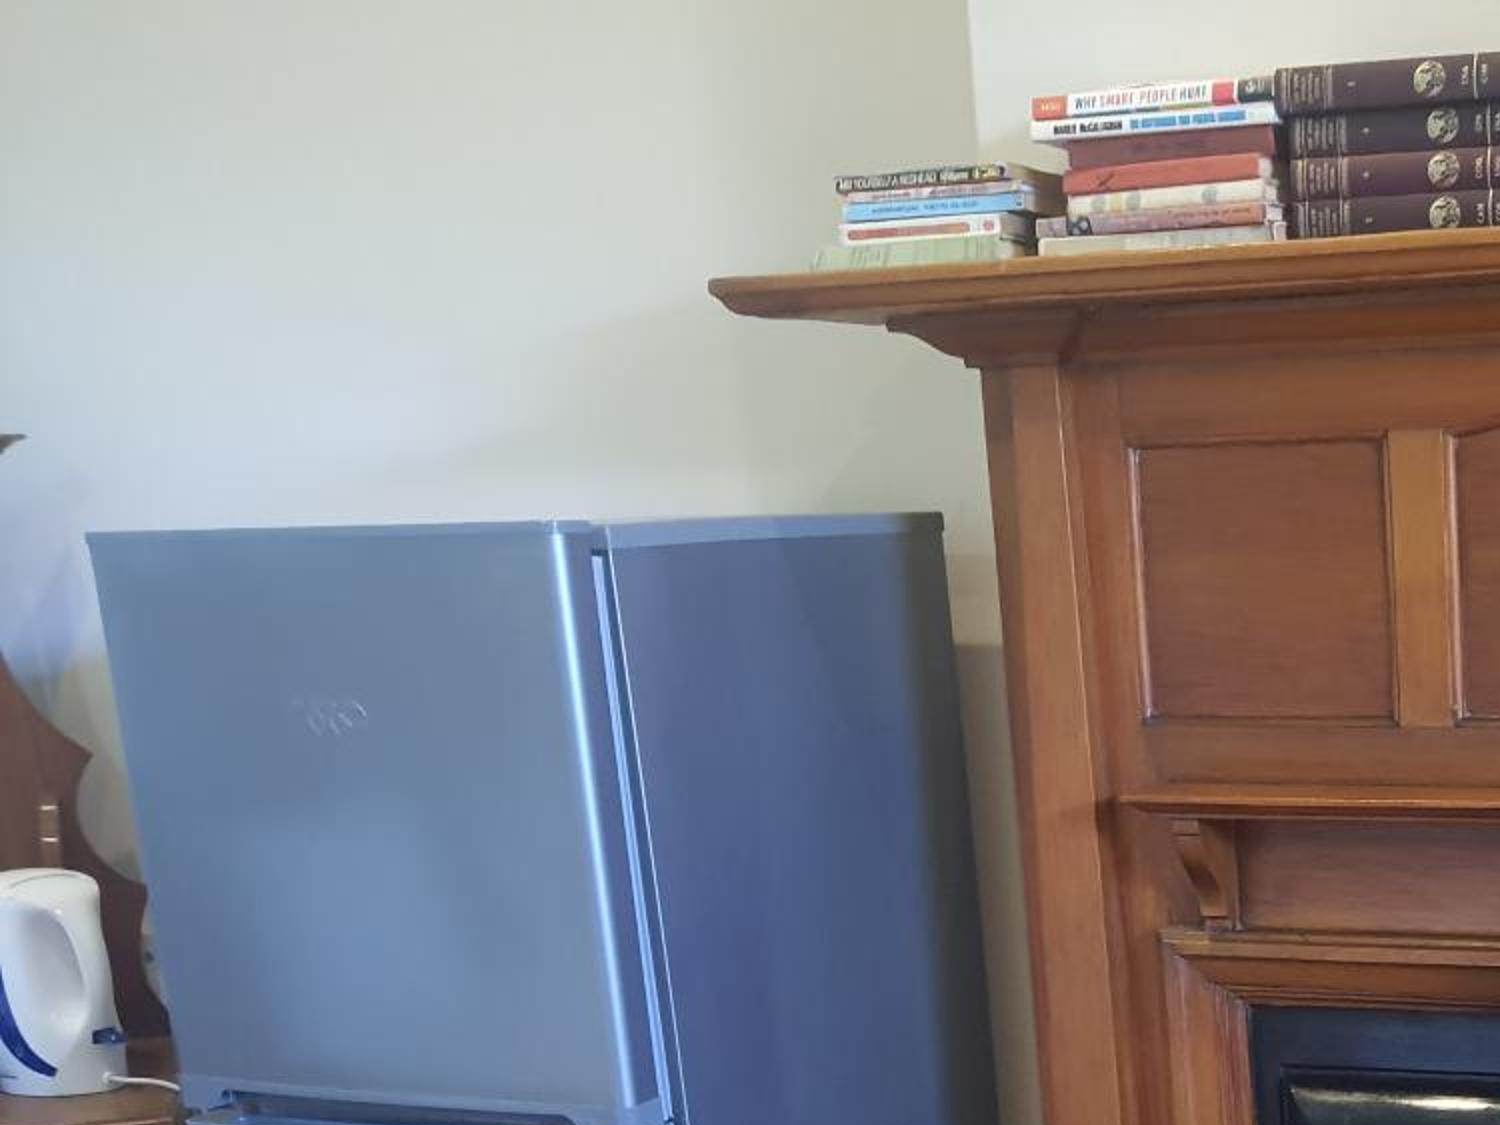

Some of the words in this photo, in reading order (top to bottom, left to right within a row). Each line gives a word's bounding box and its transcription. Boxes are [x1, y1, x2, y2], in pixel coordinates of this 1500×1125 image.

[1075, 94, 1098, 111] WHY
[1099, 91, 1134, 108] SMART
[1138, 87, 1178, 104] PEOPLE
[1179, 83, 1207, 101] HURT
